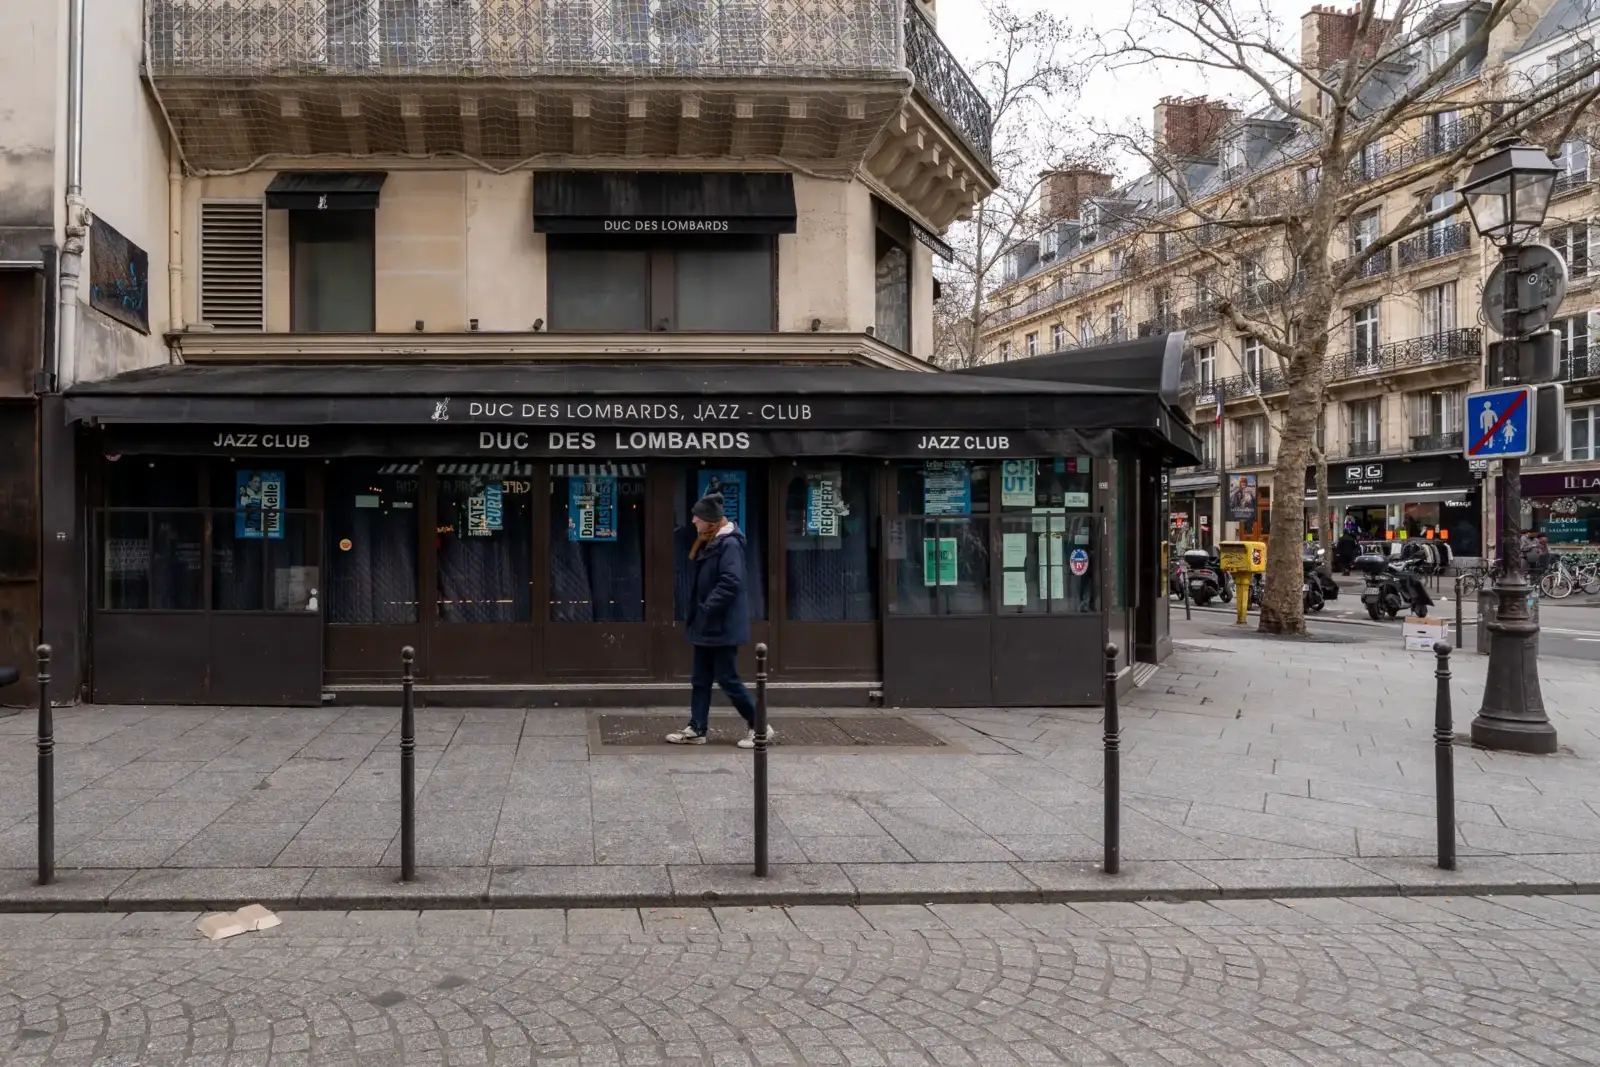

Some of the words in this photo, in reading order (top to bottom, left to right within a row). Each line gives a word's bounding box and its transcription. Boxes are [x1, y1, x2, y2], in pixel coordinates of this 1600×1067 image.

[604, 220, 631, 231] DUC
[635, 220, 658, 231] DES
[661, 220, 729, 231] LOMBARDS
[469, 402, 514, 417] DUC
[522, 403, 559, 418] DES
[567, 403, 685, 421] LOMBARDS,
[761, 403, 812, 420] CLUB
[213, 433, 258, 448] JAZZ
[262, 434, 310, 449] CLUB
[479, 431, 529, 449] DUC
[548, 431, 596, 449] DES
[615, 431, 750, 450] LOMBARDS
[917, 435, 960, 449] JAZZ
[964, 435, 1010, 450] CLUB
[1346, 465, 1382, 479] RG
[470, 499, 484, 528] KATE
[486, 486, 502, 527] CURLY
[808, 489, 821, 529] Gustave
[820, 482, 833, 534] REICHERT
[581, 510, 593, 537] Dana
[1548, 512, 1579, 524] Lesca
